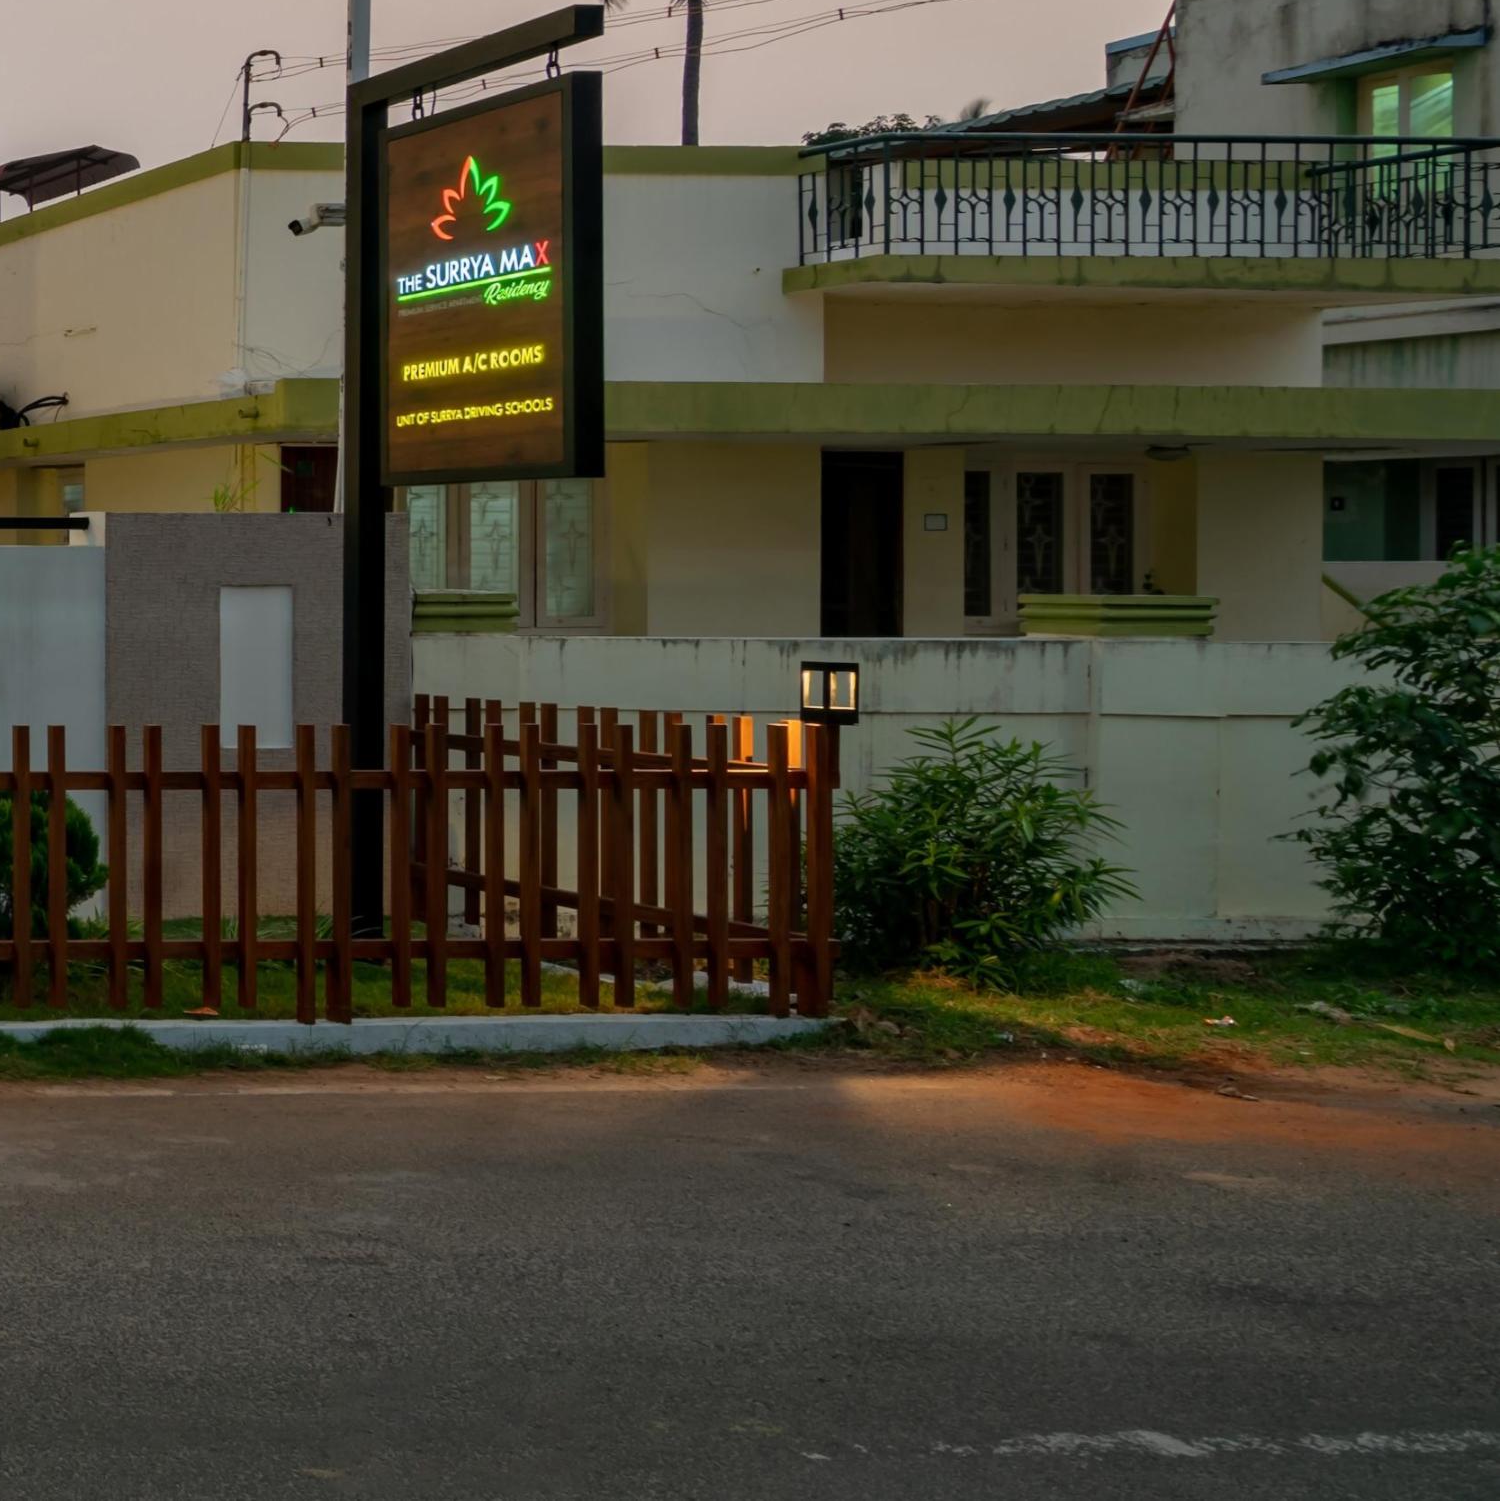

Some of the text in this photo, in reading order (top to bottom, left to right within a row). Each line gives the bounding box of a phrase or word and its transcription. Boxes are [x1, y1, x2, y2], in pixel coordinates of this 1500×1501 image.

[396, 241, 549, 295] THE SURRYA MAX
[484, 279, 550, 305] Residency
[403, 345, 544, 382] PREMIUM A/C ROOMS
[396, 397, 554, 427] UNIT OF SURRYA DRIVING SCHOOLS
